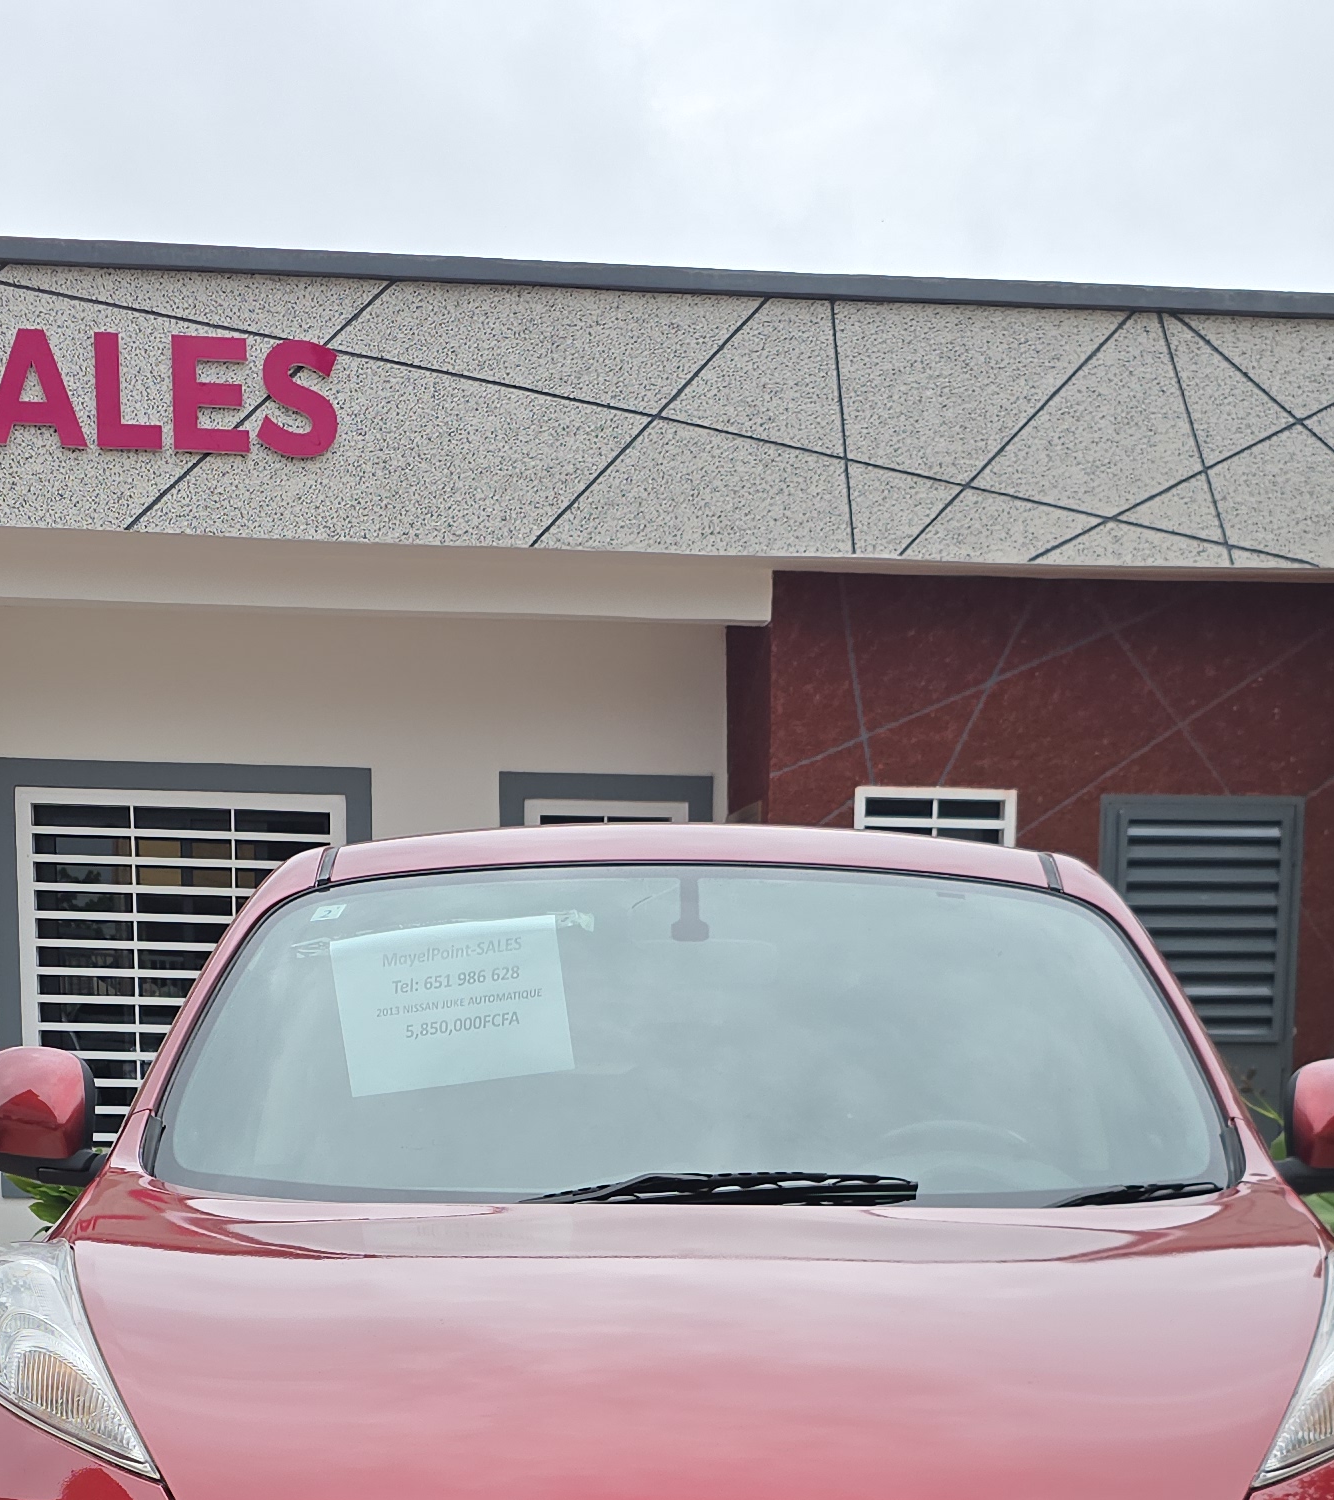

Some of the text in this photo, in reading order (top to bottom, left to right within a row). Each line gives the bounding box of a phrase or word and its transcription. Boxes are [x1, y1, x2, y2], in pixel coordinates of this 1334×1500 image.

[382, 936, 522, 968] MayelPoint-SALES
[392, 965, 520, 995] Tel: 651 986 628
[376, 987, 543, 1018] 2013 NISSAN JUKE AUTOMATIQUE
[405, 1010, 520, 1040] 5,850,000FCFA
